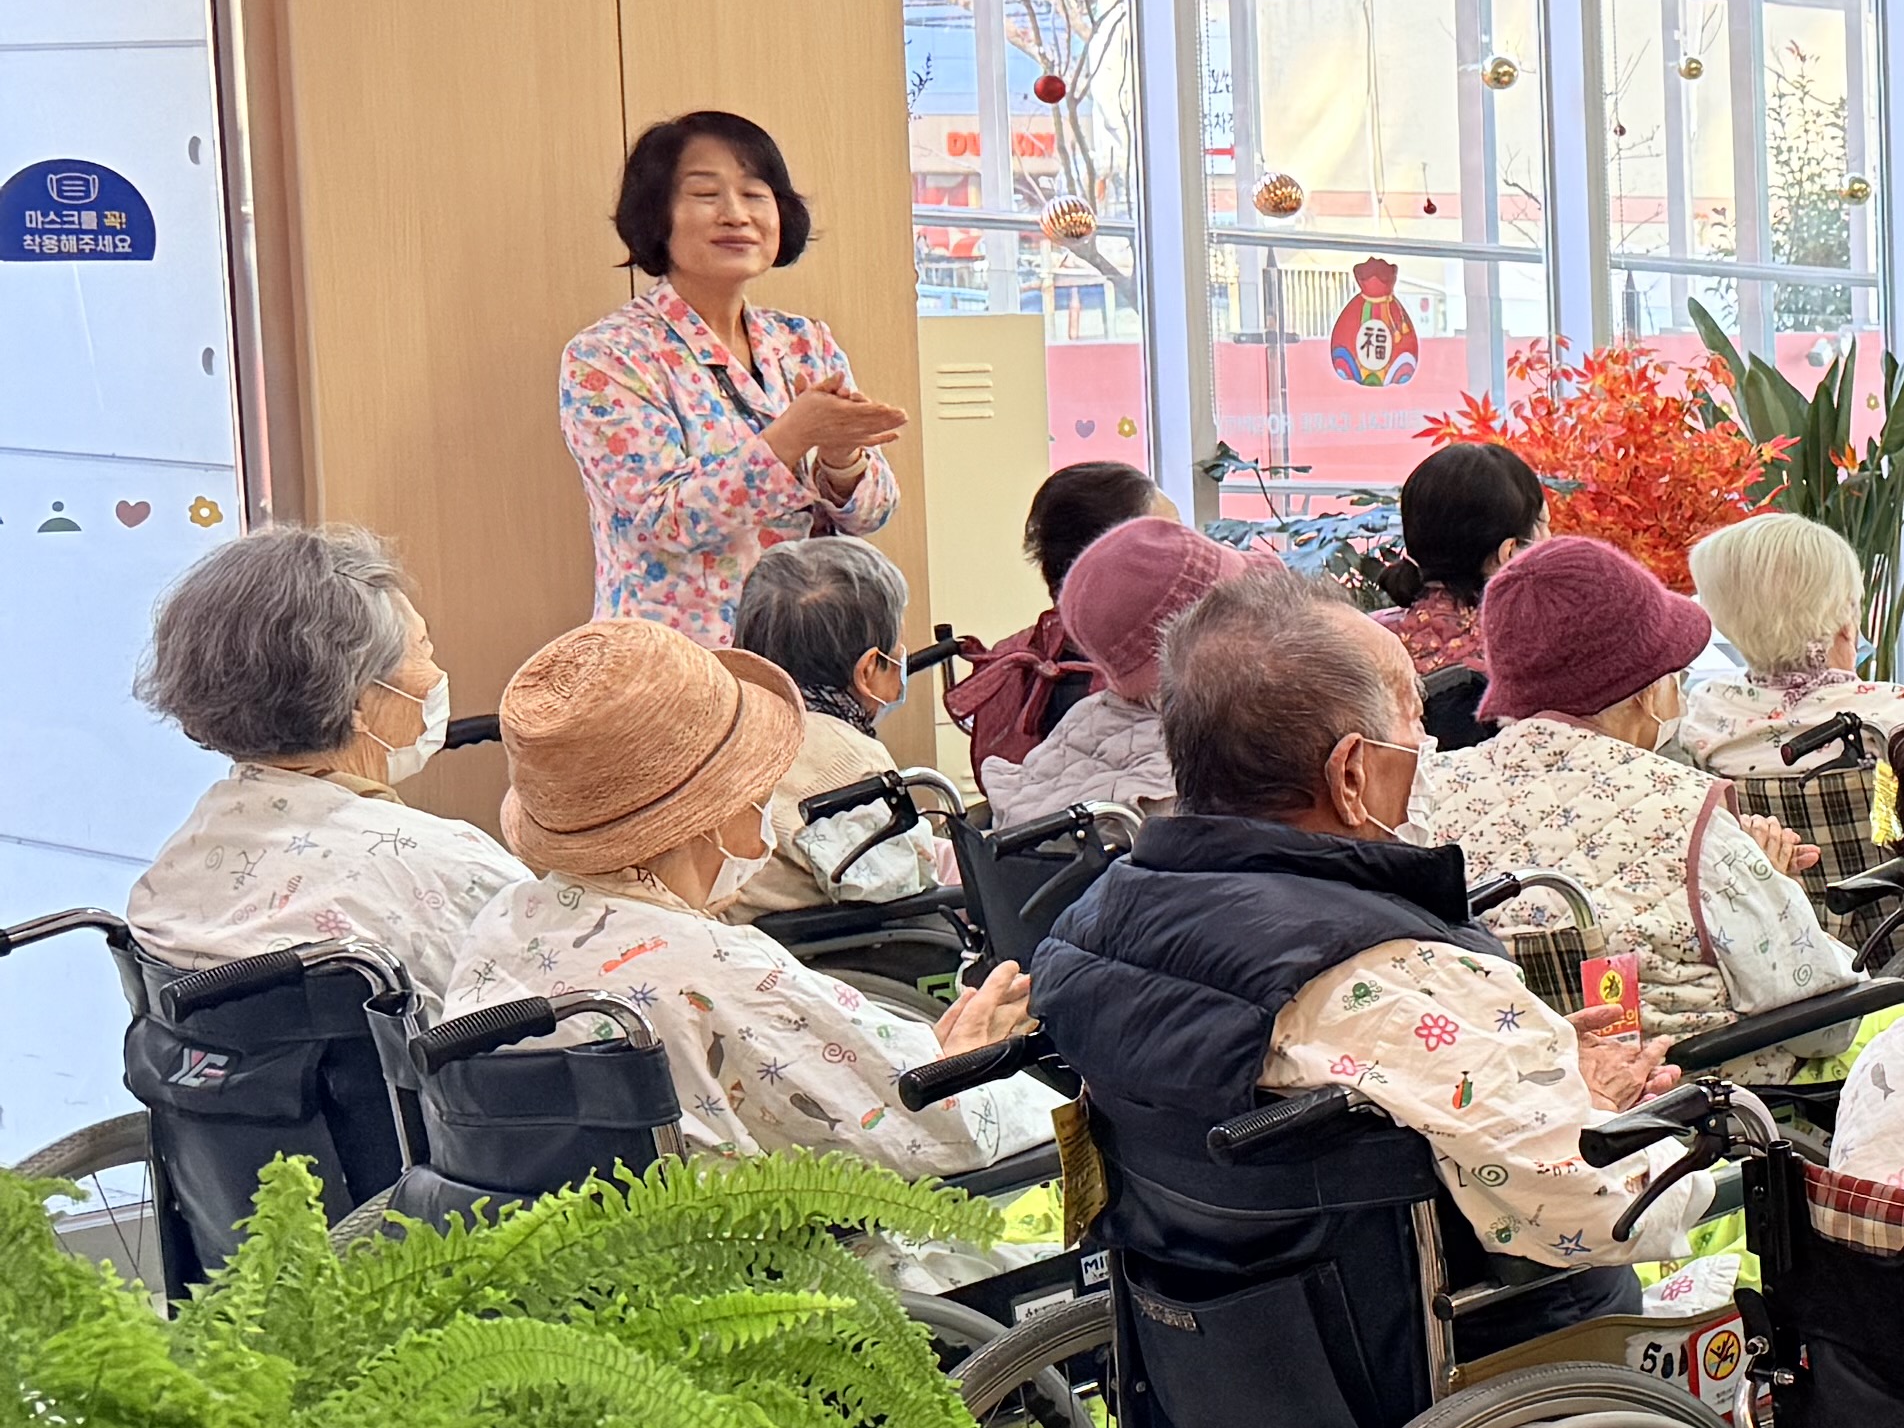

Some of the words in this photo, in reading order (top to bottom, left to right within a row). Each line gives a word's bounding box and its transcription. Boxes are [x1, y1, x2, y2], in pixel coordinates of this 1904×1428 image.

[946, 131, 1057, 158] DUKIN
[24, 210, 98, 231] 마스크를
[103, 210, 127, 231] 꼭!
[22, 233, 133, 255] 착용해주세요
[1359, 325, 1389, 362] 福
